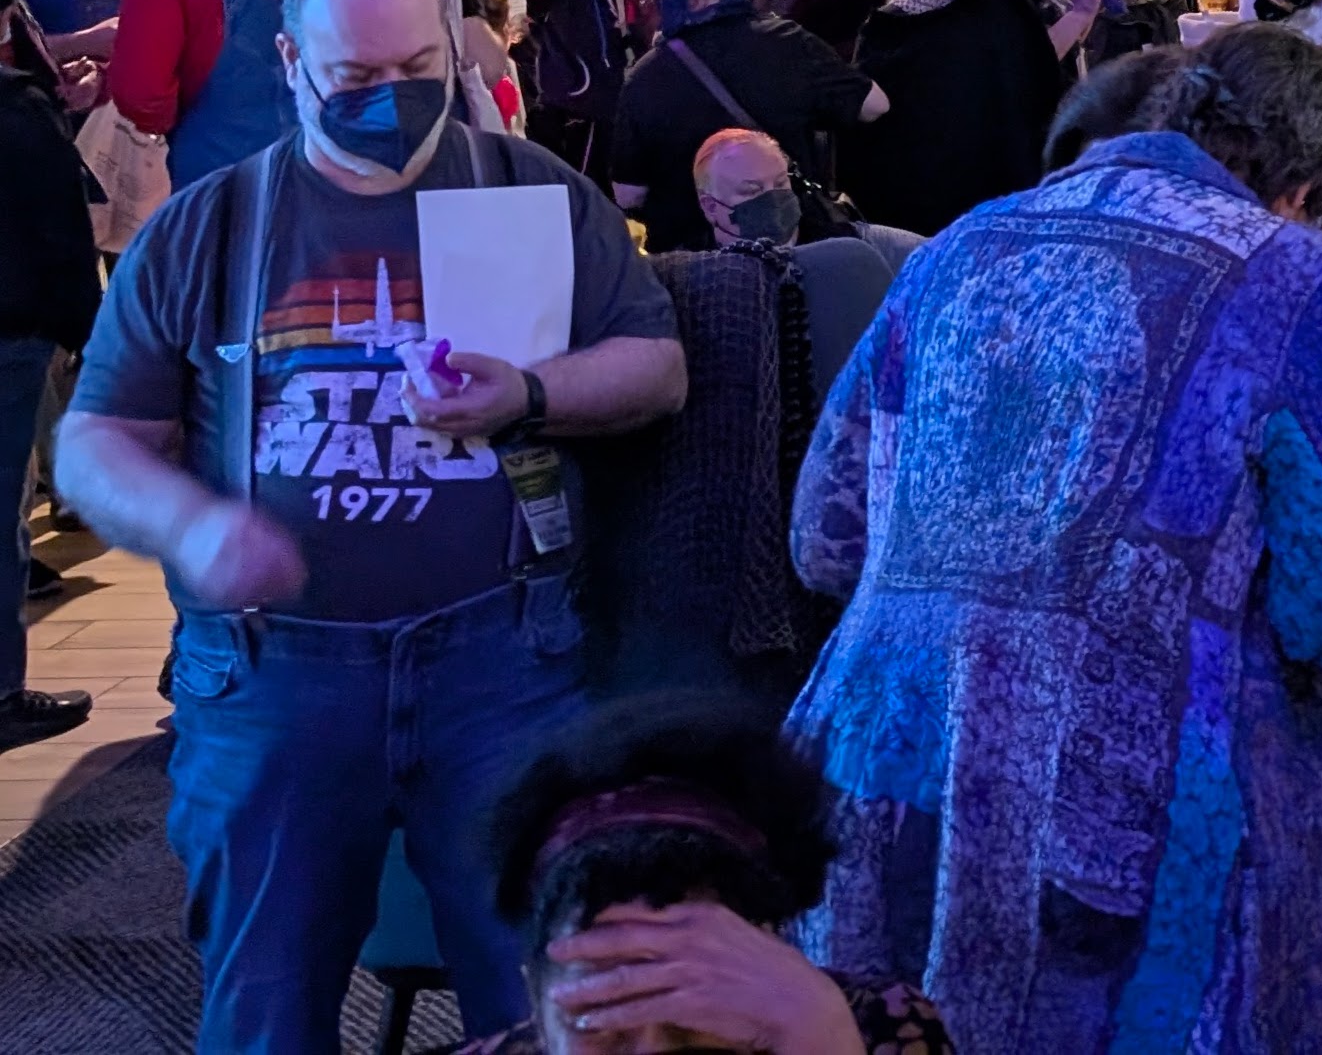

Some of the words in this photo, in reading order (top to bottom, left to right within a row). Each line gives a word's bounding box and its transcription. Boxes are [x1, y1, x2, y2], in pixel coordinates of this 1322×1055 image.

[258, 371, 407, 423] STA
[255, 422, 499, 480] WARS
[312, 485, 433, 523] 1977
